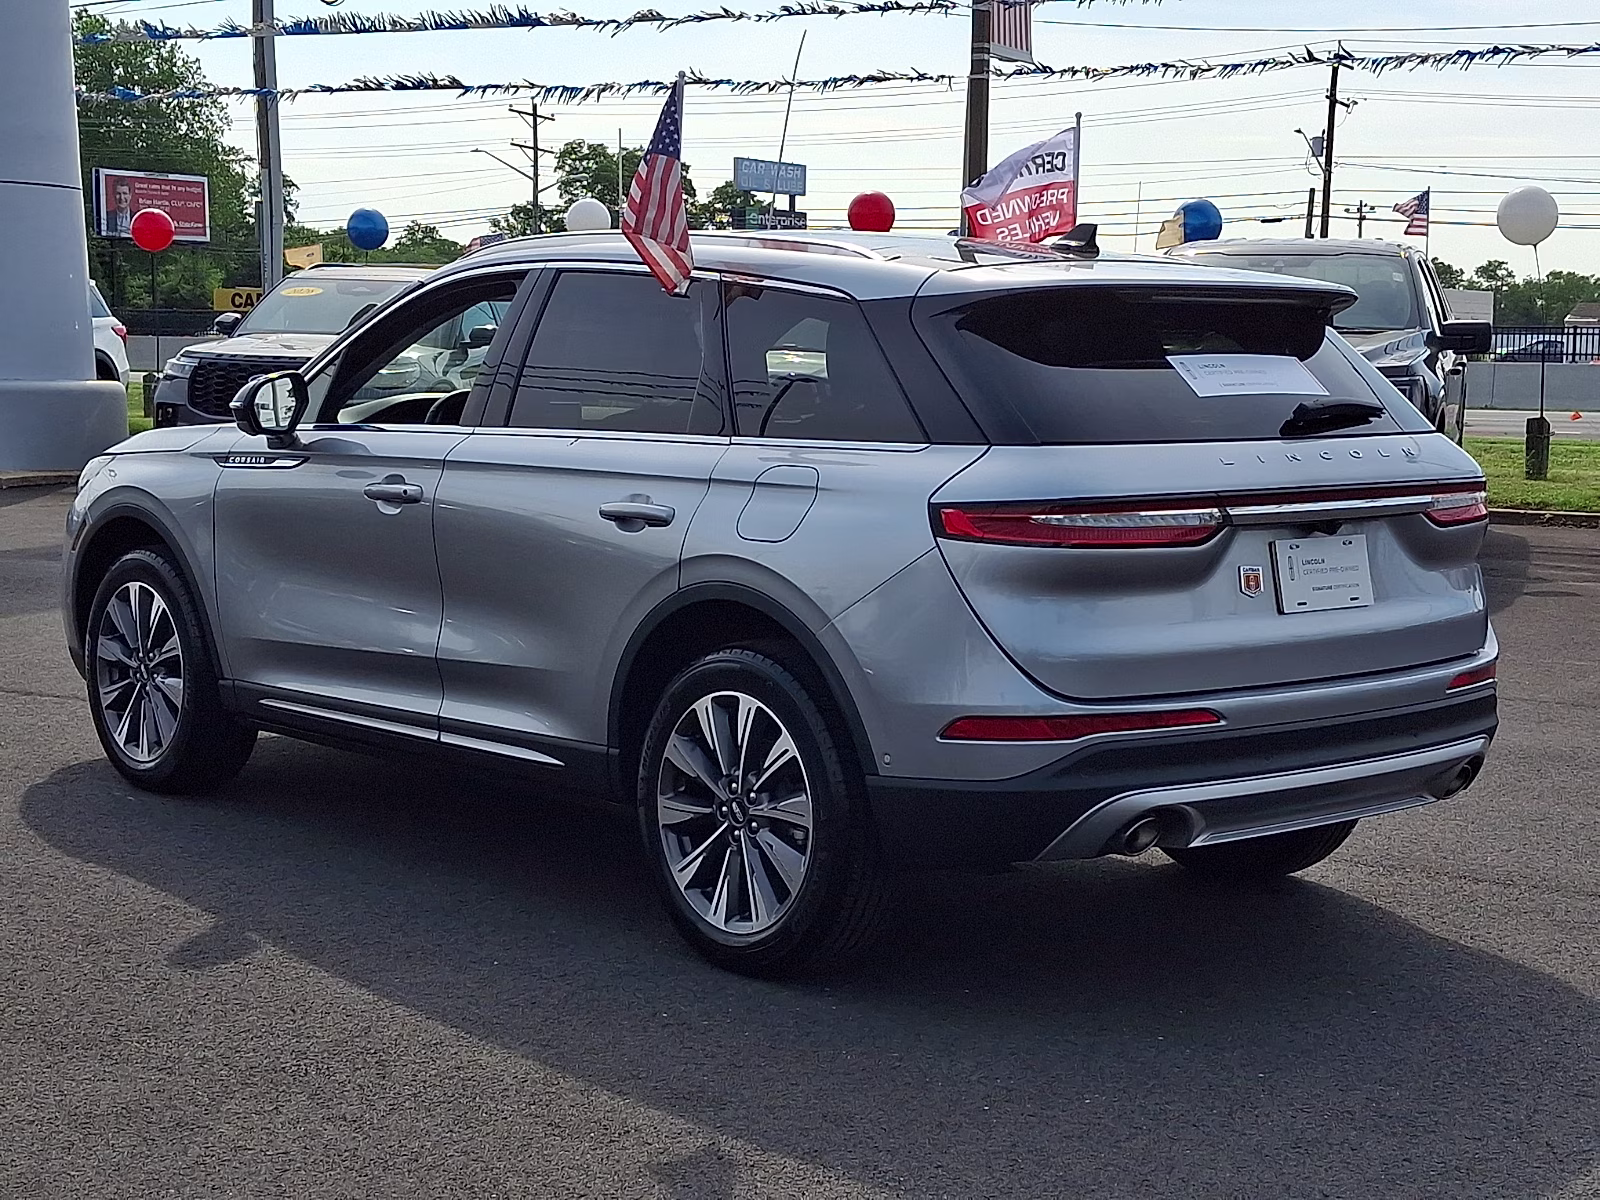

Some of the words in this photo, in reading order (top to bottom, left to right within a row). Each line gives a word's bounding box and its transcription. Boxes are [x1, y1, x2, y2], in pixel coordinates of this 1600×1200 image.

[742, 161, 765, 175] CAR
[770, 164, 802, 178] WASH
[741, 176, 758, 188] OIL
[777, 180, 804, 192] LUBE
[748, 212, 806, 228] enterprise
[228, 456, 266, 464] CORSAIR
[1218, 446, 1416, 467] LINCOLN
[1301, 558, 1326, 566] LINCOLN
[1302, 567, 1329, 576] CERTIFIED
